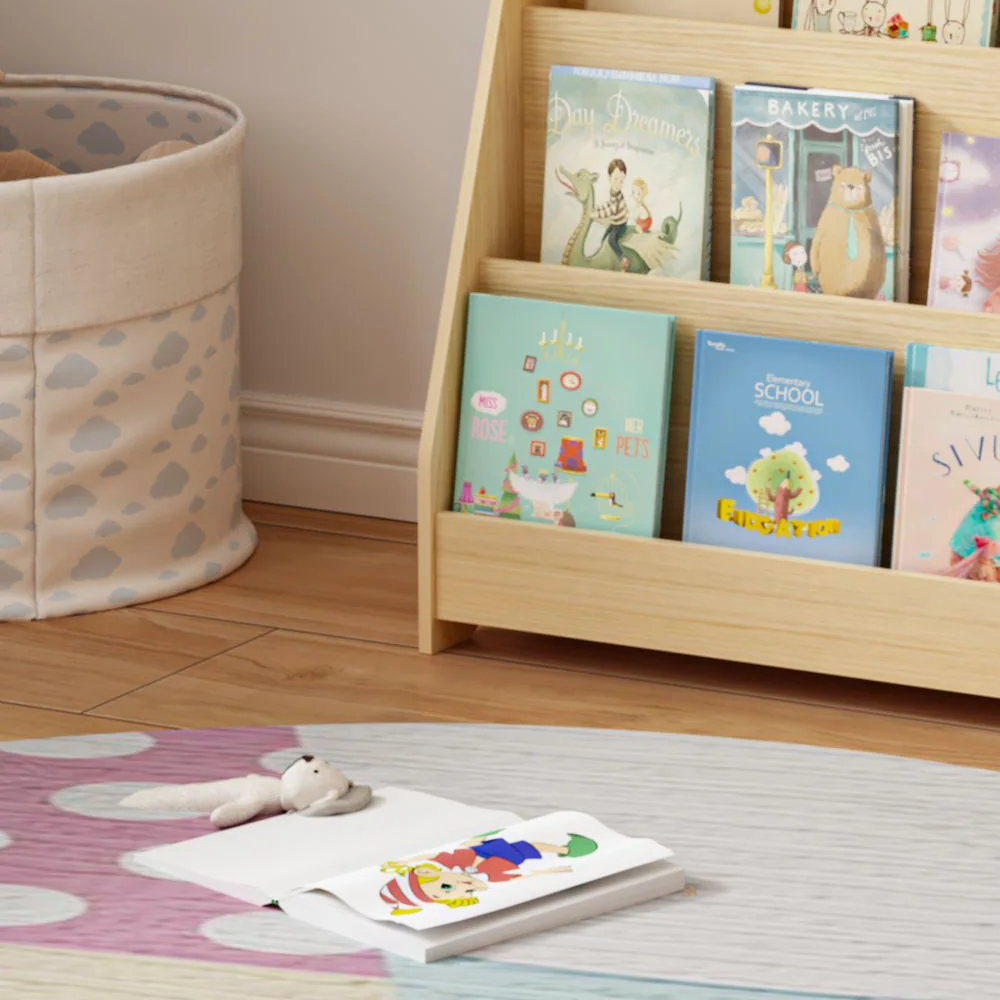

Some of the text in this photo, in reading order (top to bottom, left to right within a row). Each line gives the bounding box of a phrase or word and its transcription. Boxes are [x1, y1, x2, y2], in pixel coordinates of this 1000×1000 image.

[767, 98, 849, 120] BAKERY
[547, 89, 701, 155] Day Dreamers
[766, 372, 812, 389] Elementary
[478, 395, 498, 410] MISS
[754, 381, 825, 407] SCHOOL
[471, 416, 508, 443] ROSE
[616, 436, 649, 459] PETS
